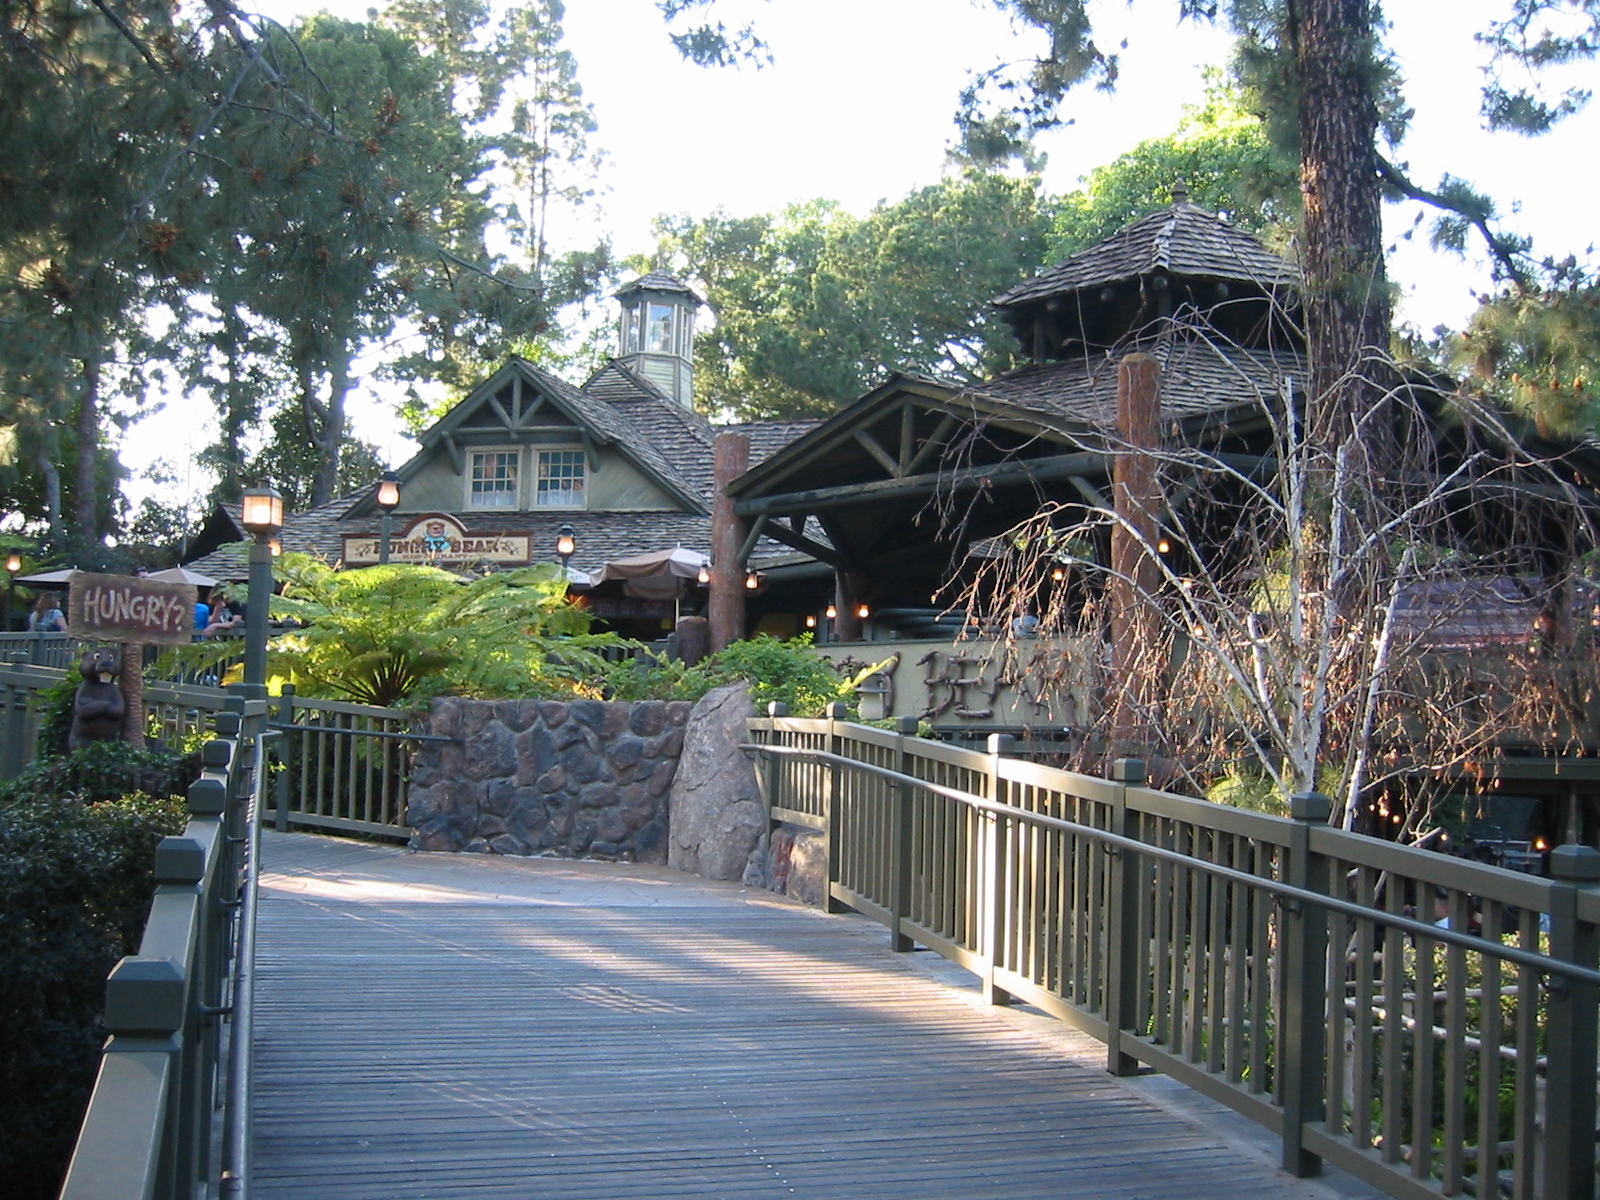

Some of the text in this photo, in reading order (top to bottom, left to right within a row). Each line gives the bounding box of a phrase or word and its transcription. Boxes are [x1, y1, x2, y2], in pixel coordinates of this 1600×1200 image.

[450, 540, 499, 553] BEAR
[83, 586, 187, 632] HUNGRY?
[916, 647, 1077, 723] BEAR
